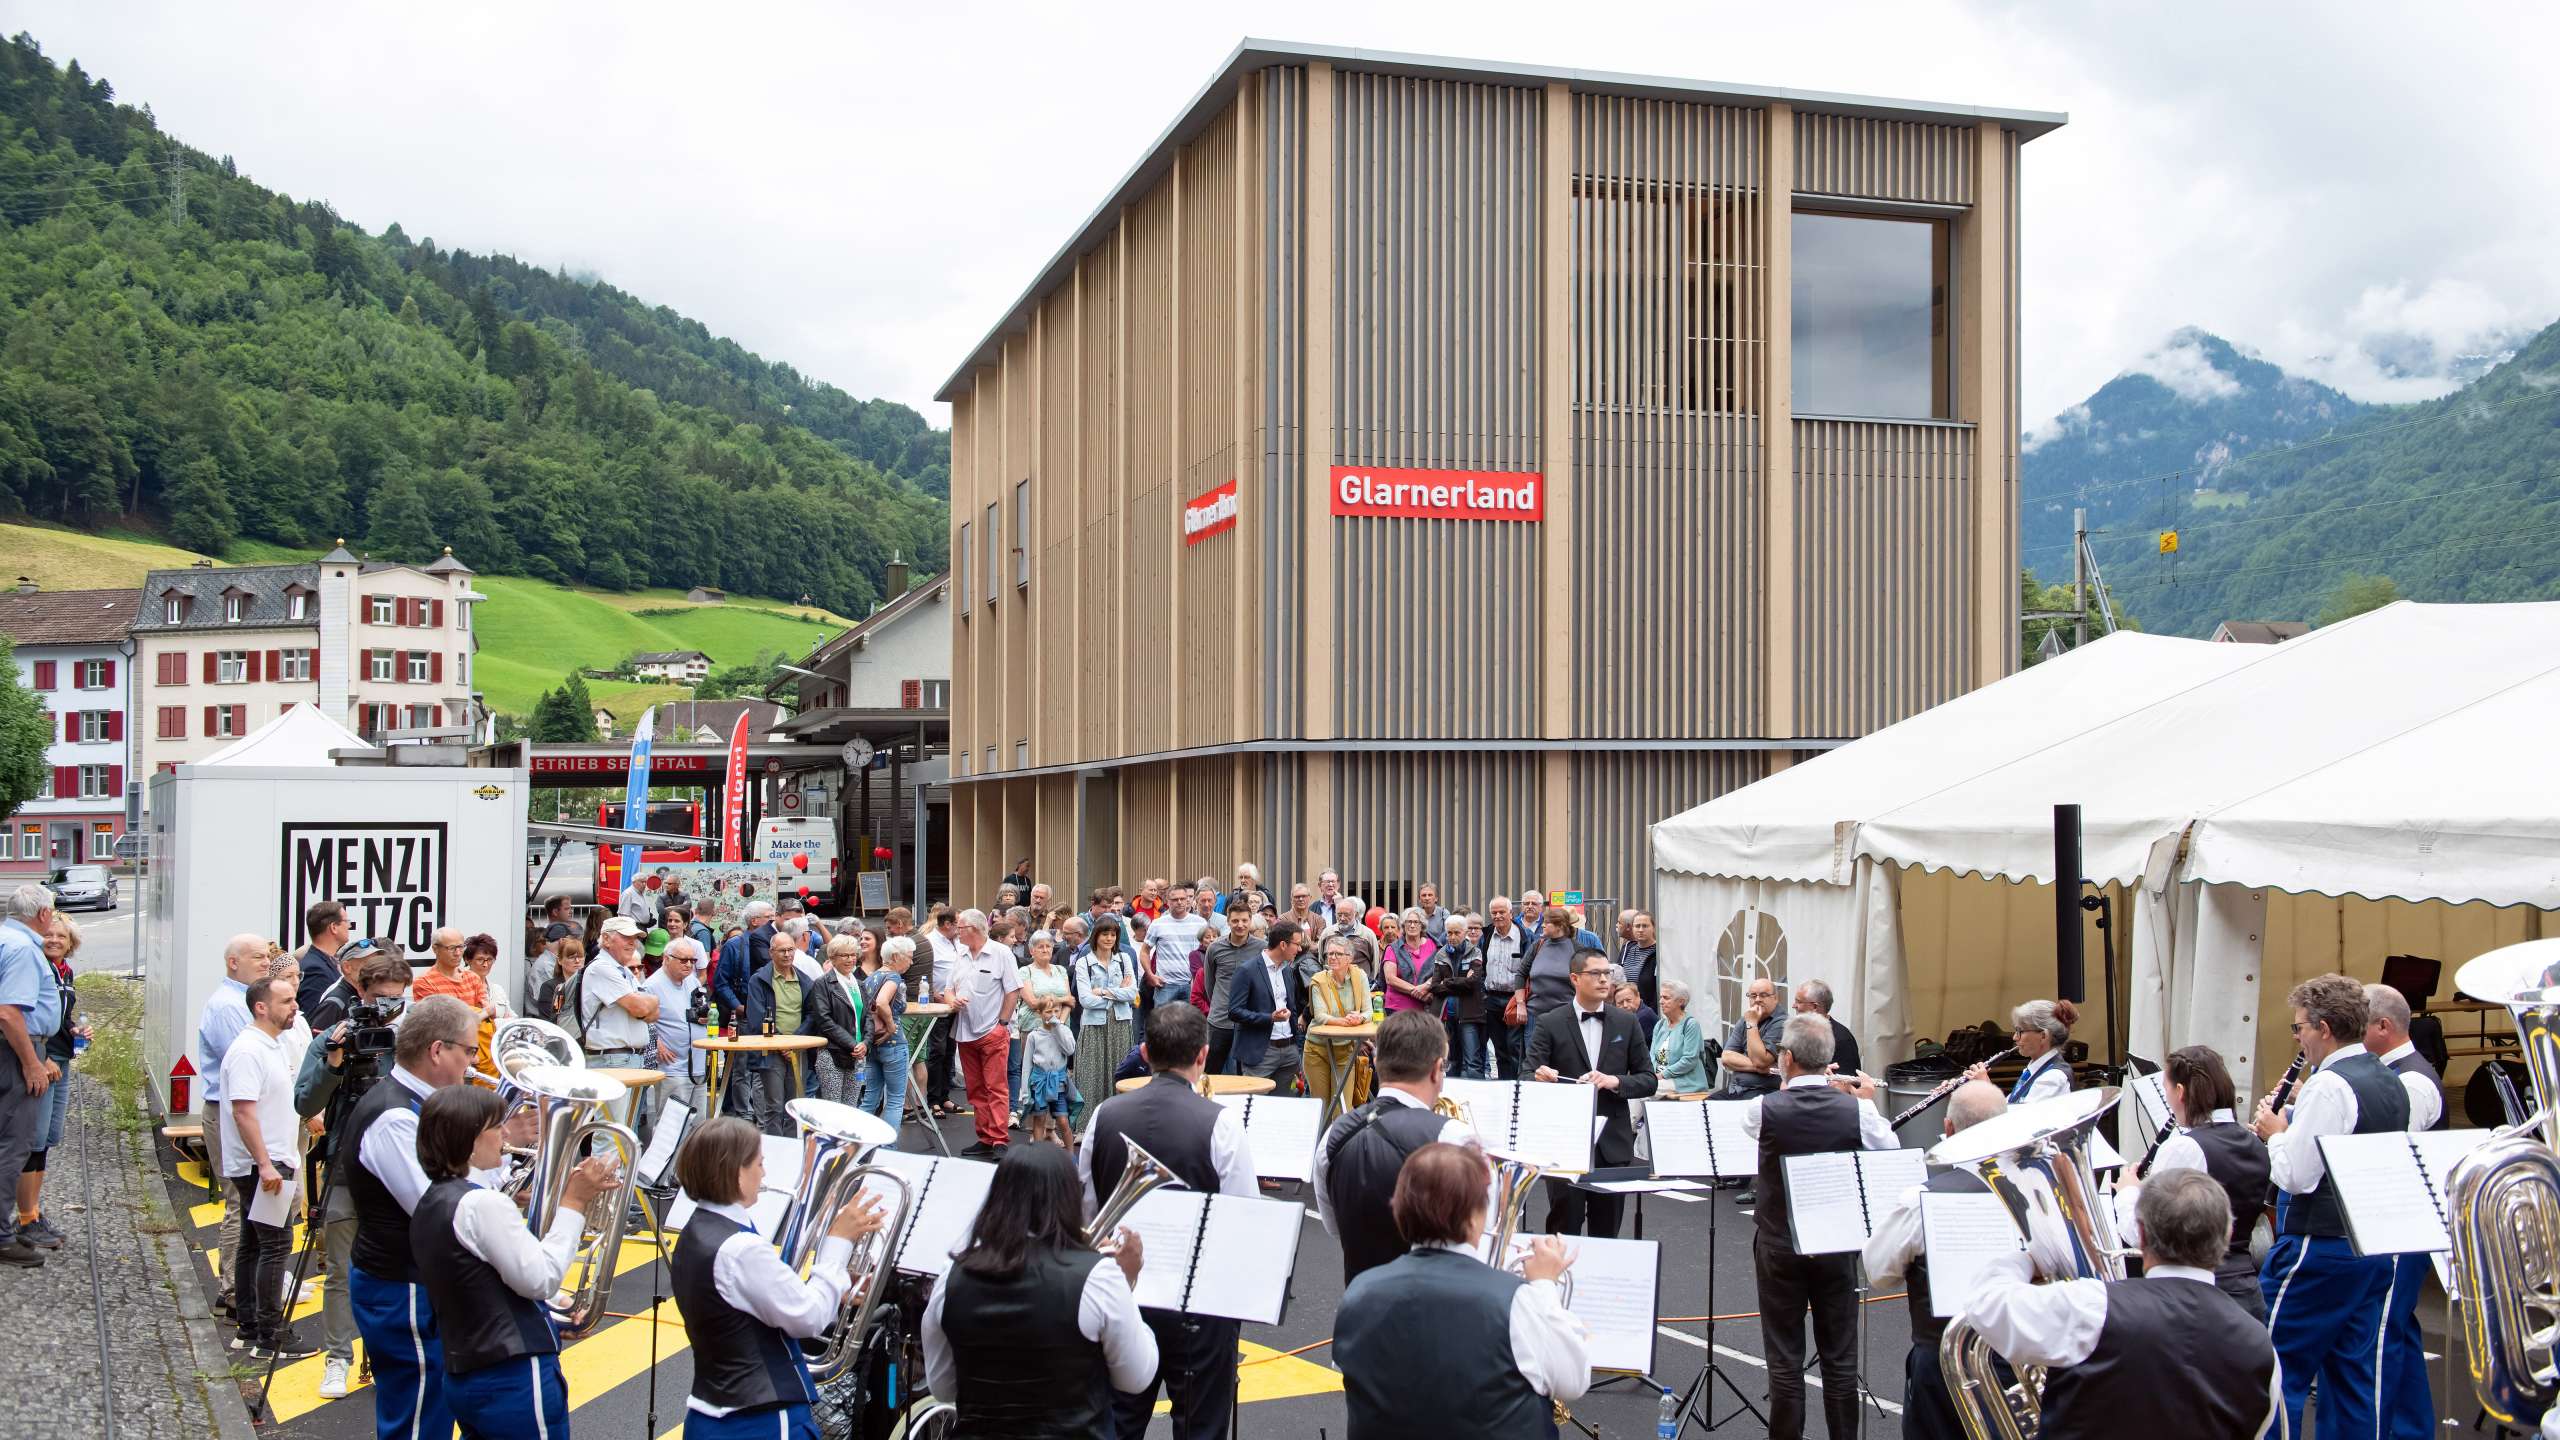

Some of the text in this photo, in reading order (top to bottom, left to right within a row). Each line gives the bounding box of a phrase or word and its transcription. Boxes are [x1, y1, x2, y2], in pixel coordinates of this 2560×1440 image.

[1339, 474, 1535, 510] Glarnerland
[530, 757, 599, 770] ETRIEB
[607, 757, 697, 770] SEFTAL
[771, 839, 821, 849] Make the
[297, 837, 431, 899] MENZI
